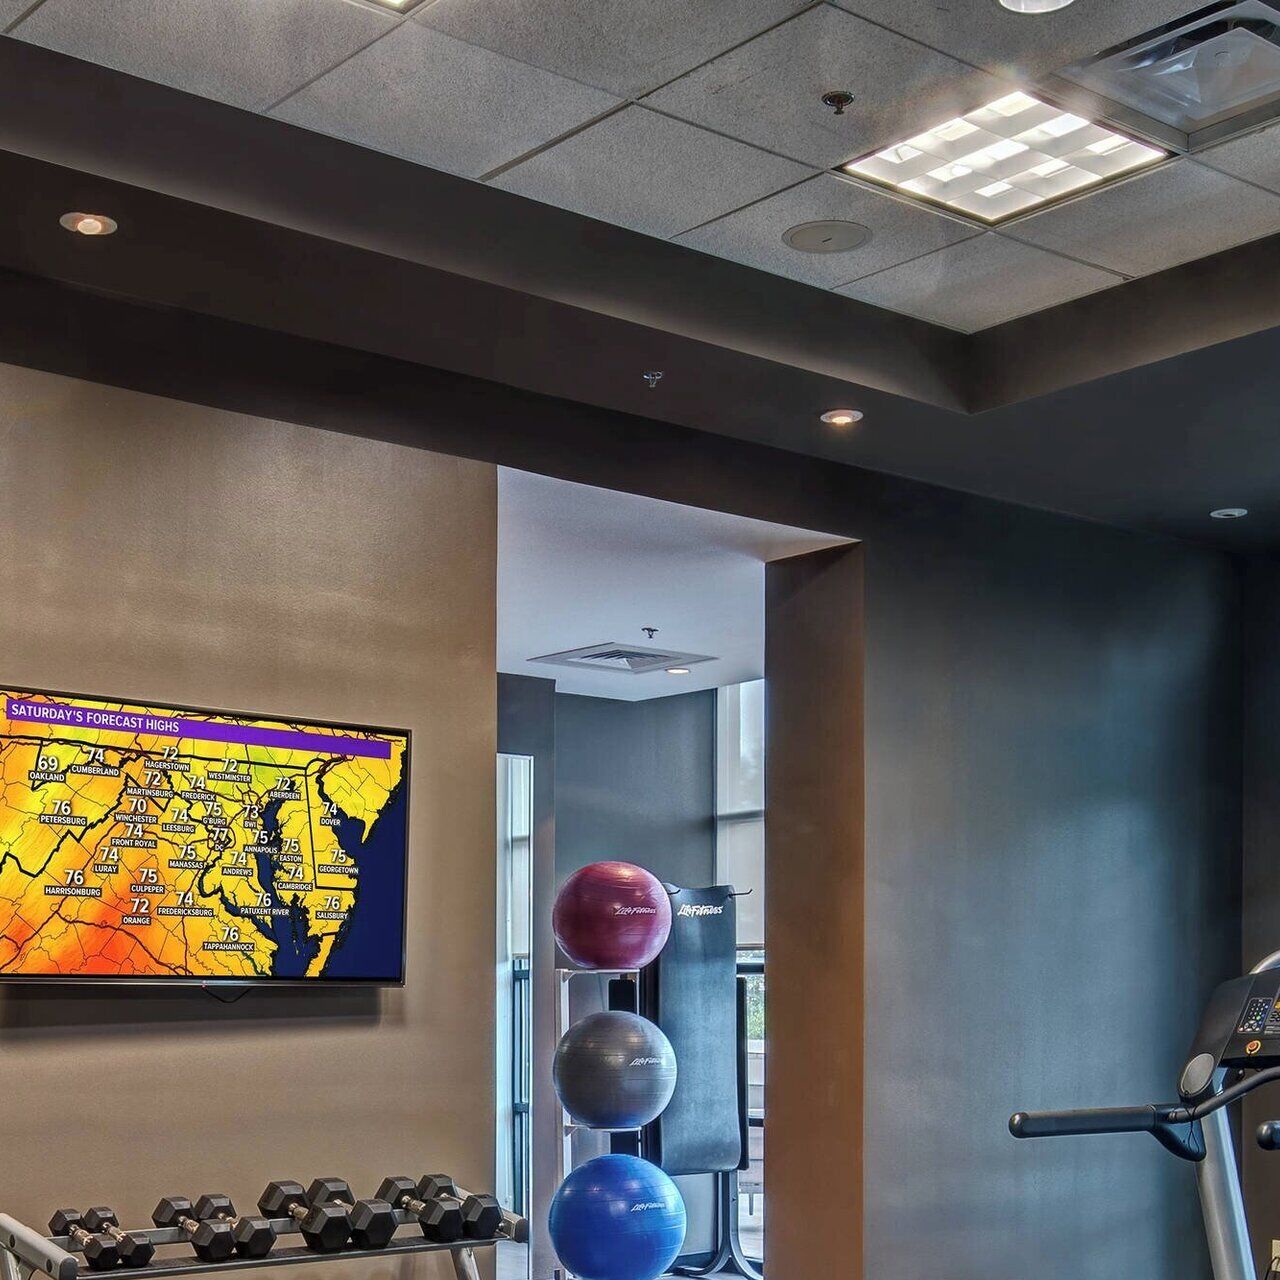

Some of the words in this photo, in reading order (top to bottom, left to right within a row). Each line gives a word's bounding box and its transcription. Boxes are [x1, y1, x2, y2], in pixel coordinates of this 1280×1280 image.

[12, 704, 83, 722] SATURDAY'S
[87, 712, 143, 728] FORECAST
[146, 720, 179, 733] HIGHS
[88, 748, 104, 762] 74
[162, 746, 178, 760] 72
[38, 755, 58, 770] 69
[145, 761, 189, 771] HAGERSTOWN
[222, 759, 238, 773] 72
[30, 772, 65, 782] OAKLAND
[72, 766, 119, 776] CUMBERLAND
[209, 773, 251, 782] WESTMINSTER
[145, 772, 161, 786] 72
[189, 775, 206, 789] 74
[276, 778, 291, 791] 72
[127, 788, 173, 798] MARTINSBURG
[182, 792, 216, 801] FREDERICK
[270, 791, 300, 800] ABERDEEN
[51, 800, 71, 816] 76
[130, 798, 146, 813] 70
[205, 802, 222, 816] 75
[243, 805, 259, 819] 73
[322, 802, 338, 815] 74
[41, 816, 86, 826] PETERSBURG
[116, 814, 157, 823] WINCHESTER
[172, 808, 189, 822] 74
[203, 817, 226, 826] G'BURG
[163, 824, 194, 833] LEESBURG
[244, 820, 257, 828] BWI
[321, 818, 341, 826] DOVER
[126, 824, 143, 838] 74
[213, 828, 229, 841] 77
[253, 831, 269, 844] 75
[112, 839, 133, 847] FRONT
[135, 840, 156, 848] ROYAL
[244, 845, 278, 854] ANNAPOLIS
[283, 839, 299, 852] 75
[101, 847, 119, 862] 74
[179, 846, 196, 860] 75
[231, 852, 247, 865] 74
[280, 855, 302, 863] EASTON
[331, 849, 346, 863] 75
[95, 865, 118, 873] LURAY
[170, 860, 204, 870] MANASSAS
[319, 865, 359, 875] GEORGETOWN
[64, 870, 84, 885] 76
[139, 869, 158, 883] 75
[222, 868, 253, 876] ANDREWS
[288, 866, 304, 880] 74
[46, 887, 101, 896] HARRISONBURG
[131, 885, 164, 893] CULPEPER
[277, 883, 313, 891] CAMBRIDGE
[176, 892, 194, 906] 74
[256, 893, 272, 907] 76
[324, 896, 340, 910] 76
[130, 899, 149, 913] 72
[158, 908, 213, 917] FREDERICKSBURG
[272, 908, 290, 916] RIVER
[123, 917, 151, 925] ORANGE
[317, 912, 349, 920] SALISBURY
[221, 927, 239, 941] 76
[204, 942, 254, 951] TAPPAHANNOCK
